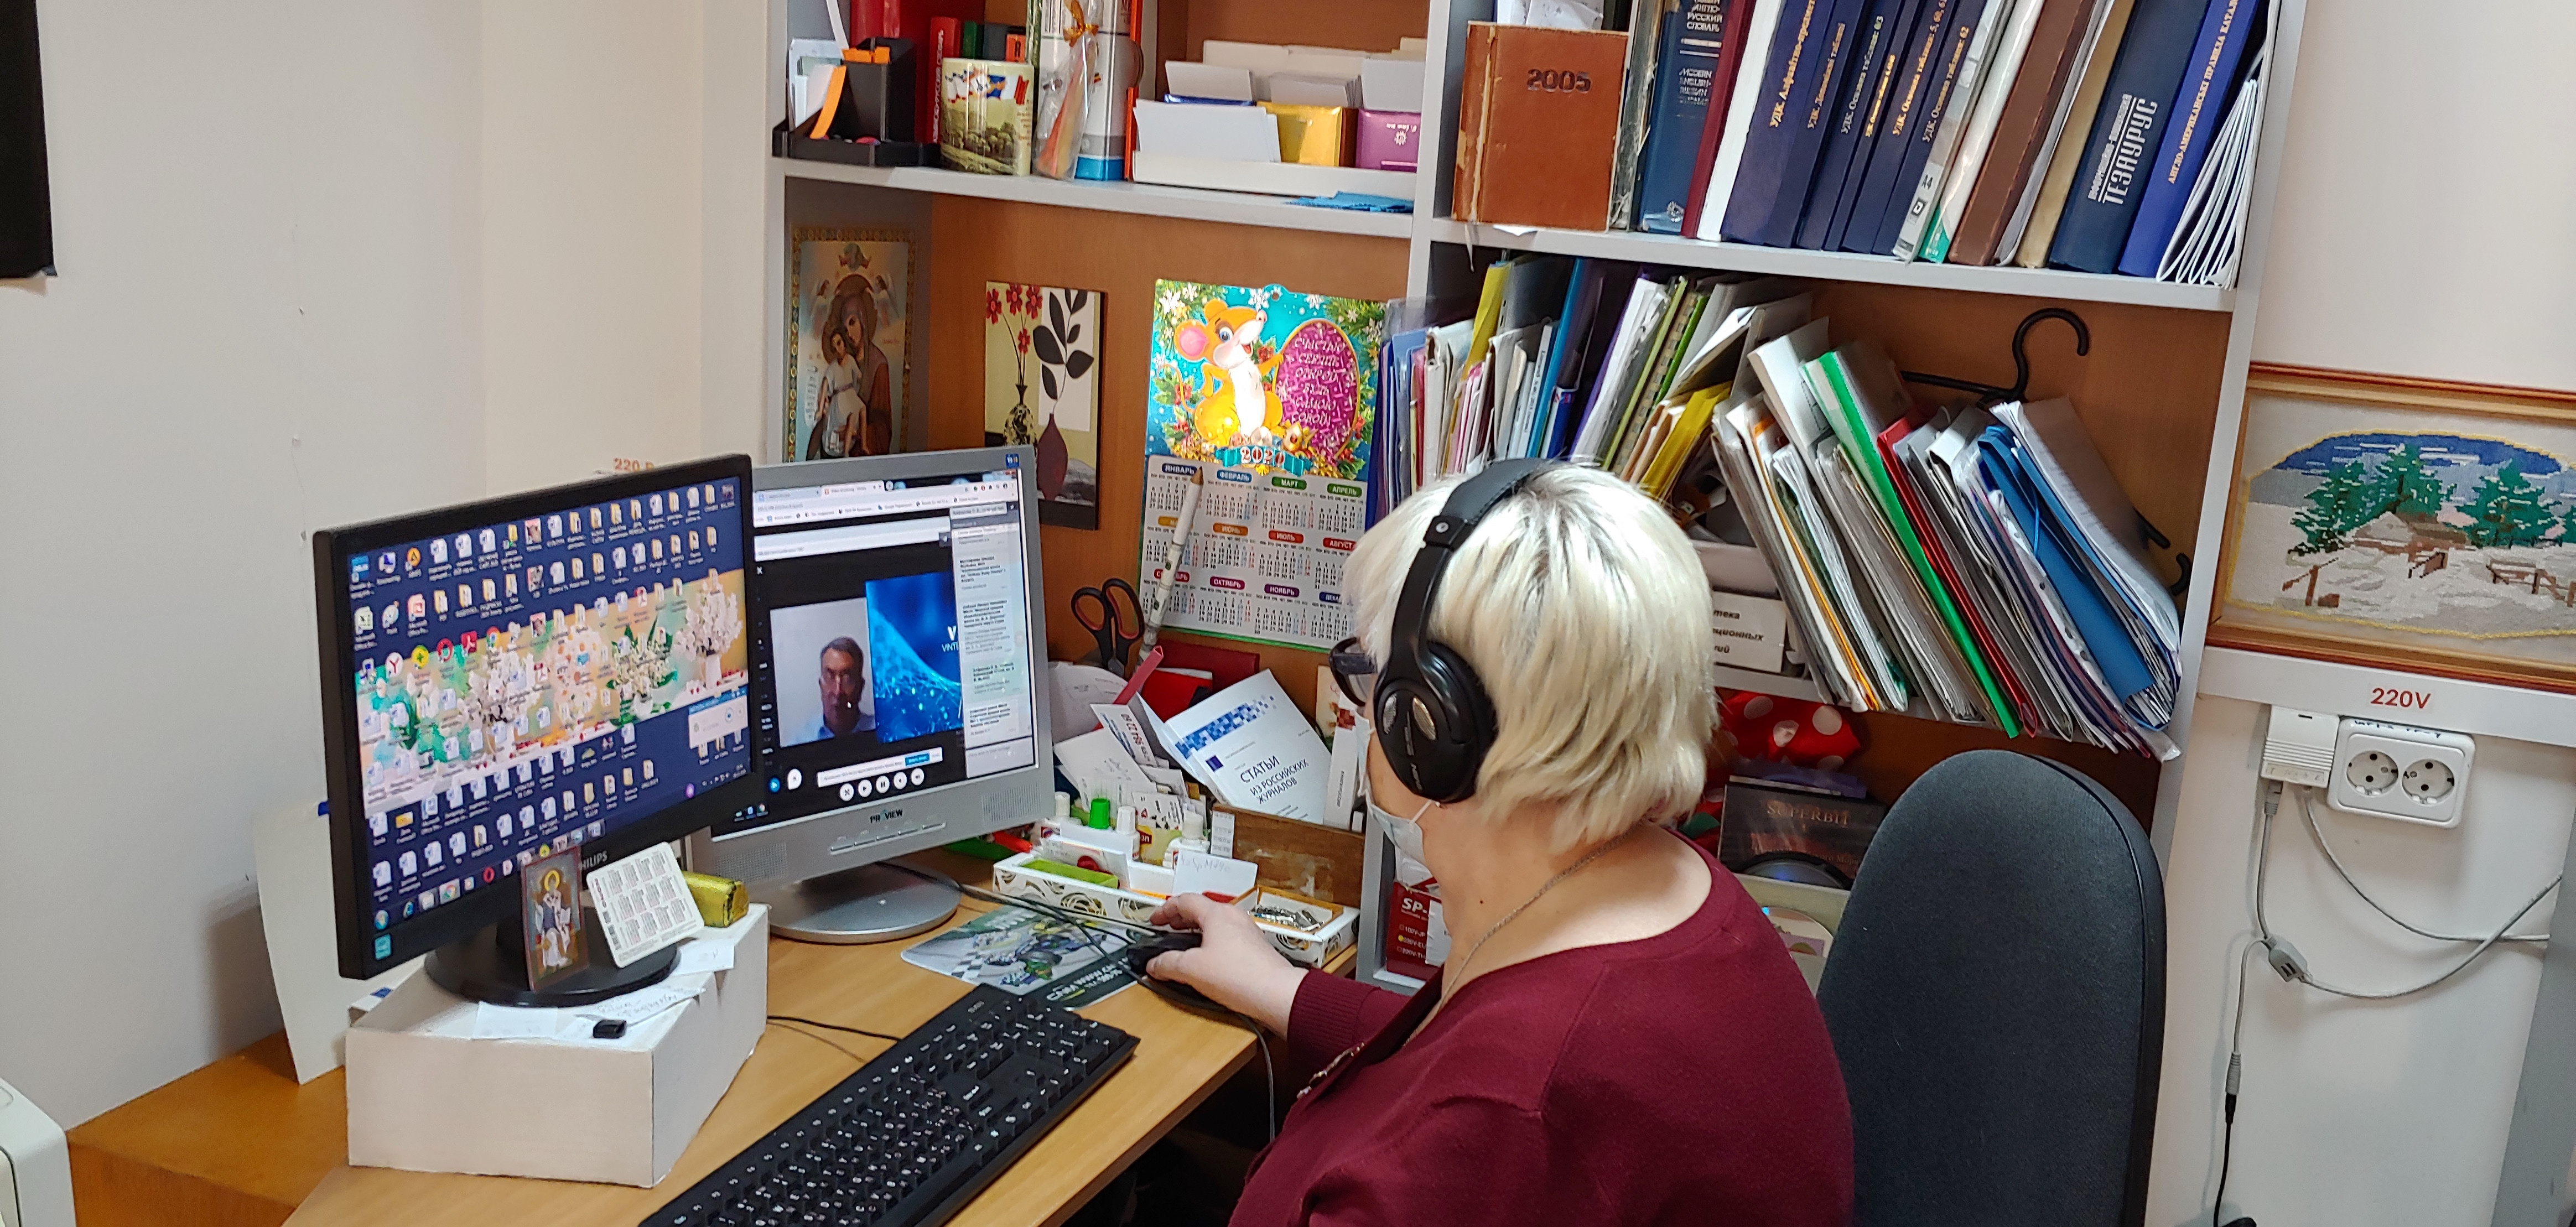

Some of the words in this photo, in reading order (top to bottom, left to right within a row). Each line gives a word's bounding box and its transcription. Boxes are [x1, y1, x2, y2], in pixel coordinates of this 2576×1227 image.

[1686, 22, 1720, 33] СЛОВАРЬ
[1687, 12, 1723, 23] РУССКИЙ
[1960, 26, 1970, 39] 62
[1526, 69, 1592, 94] 2005
[1679, 68, 1712, 79] MODERN
[2102, 98, 2158, 205] ТЕЗАУРУС
[1921, 174, 1934, 190] A4
[614, 457, 641, 472] 220
[1240, 446, 1285, 467] 2020
[1165, 465, 1194, 475] ЯНВАРЬ
[1219, 471, 1249, 482] ФЕВРАЛЬ
[1281, 479, 1299, 488] МАРТ
[1332, 487, 1357, 496] АПРЕЛЬ
[1221, 526, 1240, 534] ИЮНЬ
[1276, 532, 1296, 541] ИЮЛЬ
[1329, 540, 1352, 549] АВГУСТ
[1213, 579, 1241, 589] ОКТЯБРЬ
[1270, 586, 1295, 596] НОЯБРЬ
[2370, 688, 2432, 710] 220V
[1240, 755, 1280, 783] СТАТЬИ
[1250, 784, 1263, 796] ИЗ
[1261, 758, 1310, 789] РОССИЙСКИХ
[1258, 776, 1297, 805] ЖУРНАЛОВ
